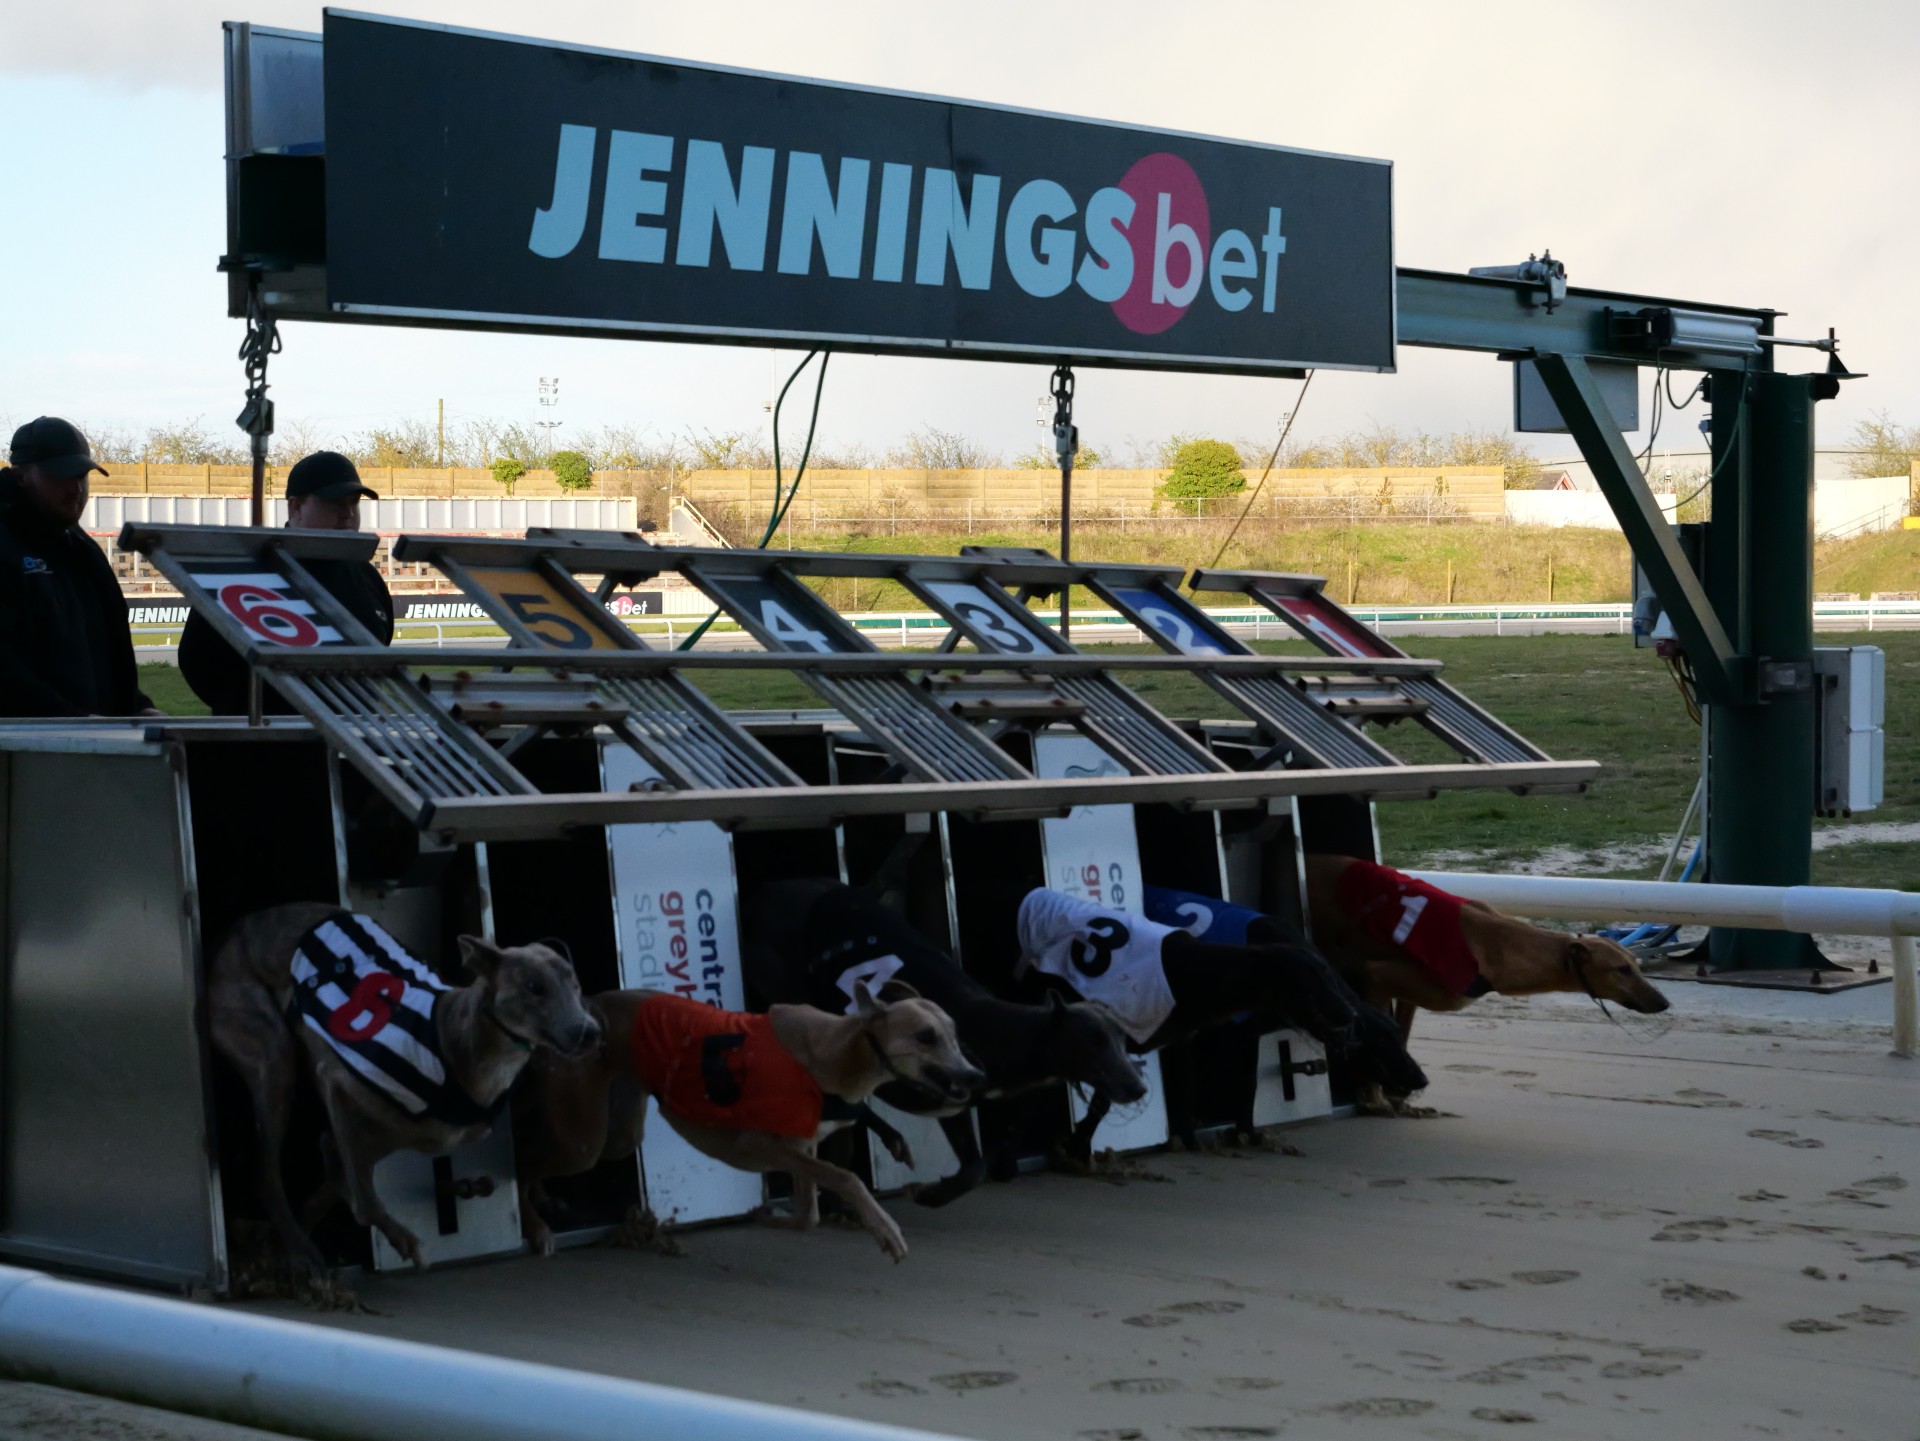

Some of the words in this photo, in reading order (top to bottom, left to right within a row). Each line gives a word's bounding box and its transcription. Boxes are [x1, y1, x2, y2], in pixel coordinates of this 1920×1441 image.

[218, 584, 320, 647] 6
[405, 603, 488, 618] JENNING
[499, 593, 593, 650] 5
[760, 600, 833, 653] 4
[954, 602, 1035, 653] 3
[1139, 607, 1224, 656] 2
[1302, 614, 1369, 658] 1
[1391, 895, 1428, 946] 1
[1071, 917, 1129, 977] 3
[327, 972, 404, 1041] 6
